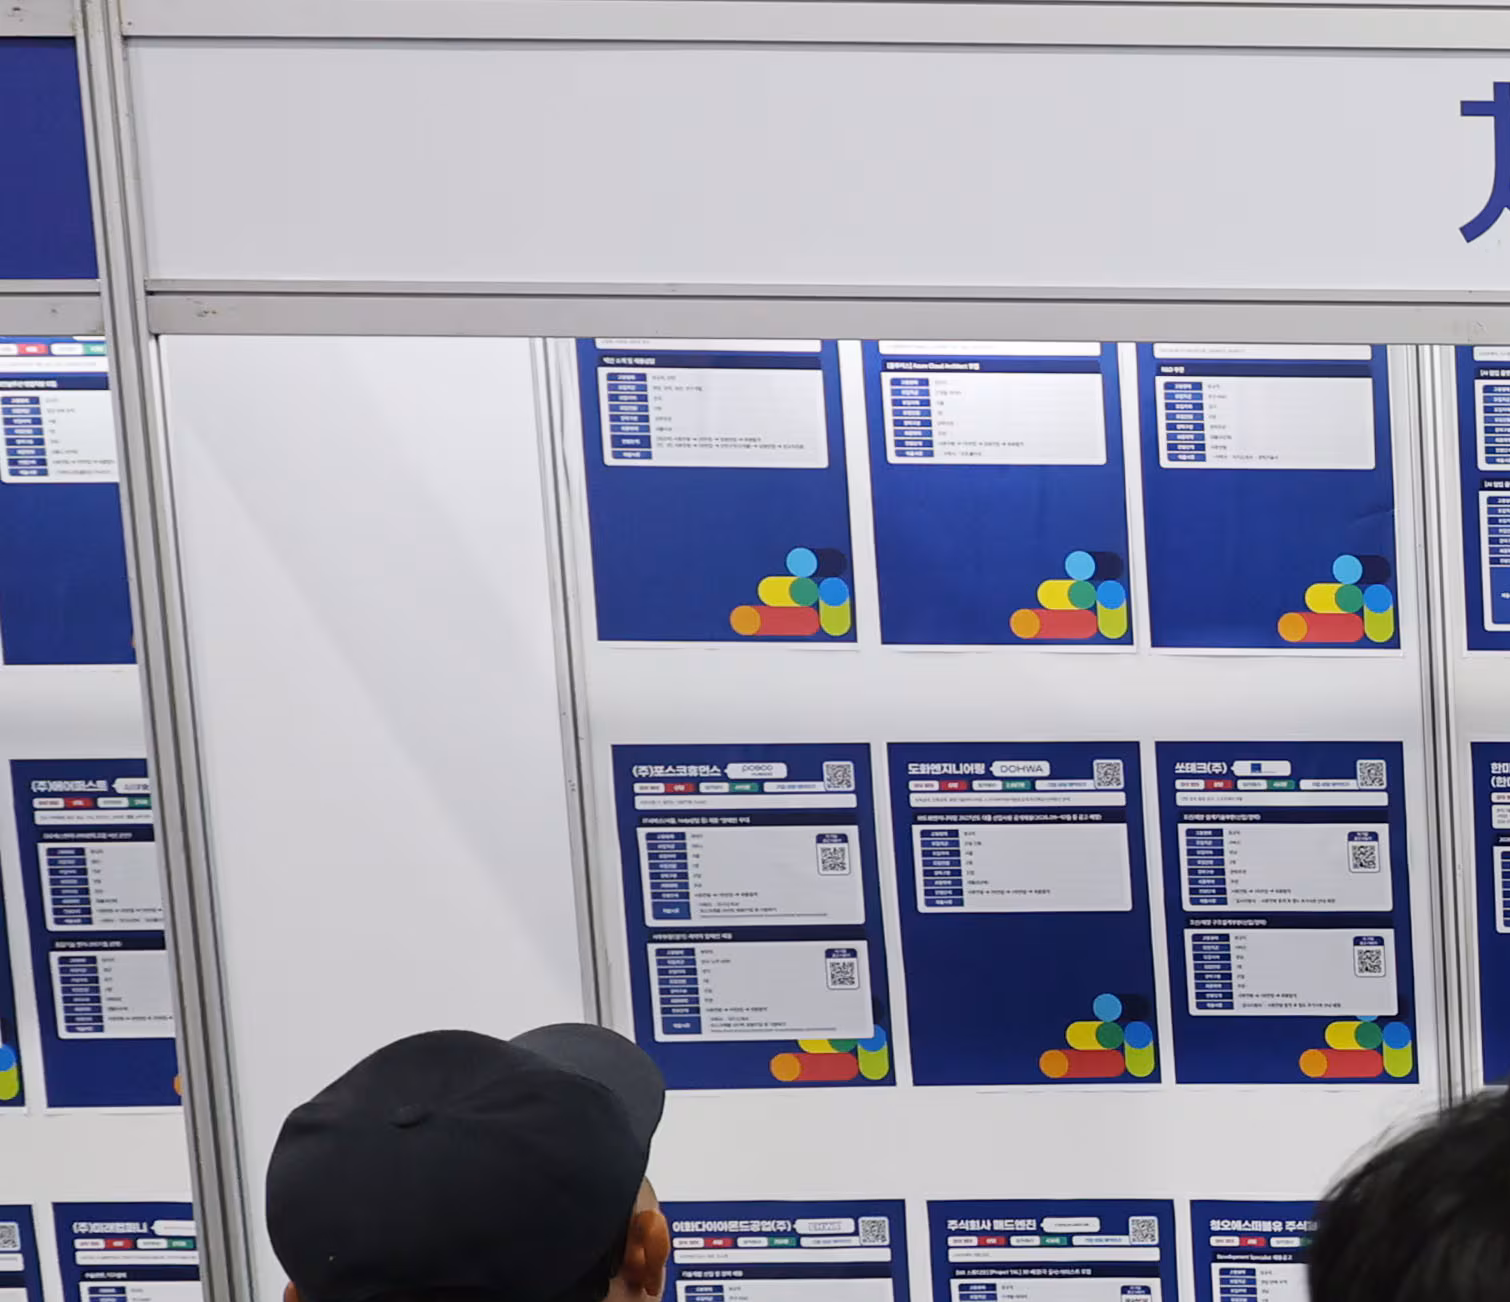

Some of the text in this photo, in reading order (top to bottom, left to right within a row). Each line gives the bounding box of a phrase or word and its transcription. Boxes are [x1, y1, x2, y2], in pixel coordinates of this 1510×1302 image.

[632, 765, 722, 777] (주)포스코휴먼스
[908, 763, 985, 775] 도화엔지니어링
[1000, 765, 1043, 773] DOHWA
[672, 1221, 791, 1232] 이화다이아몬드공업(주)
[947, 1220, 991, 1231] 주식회사
